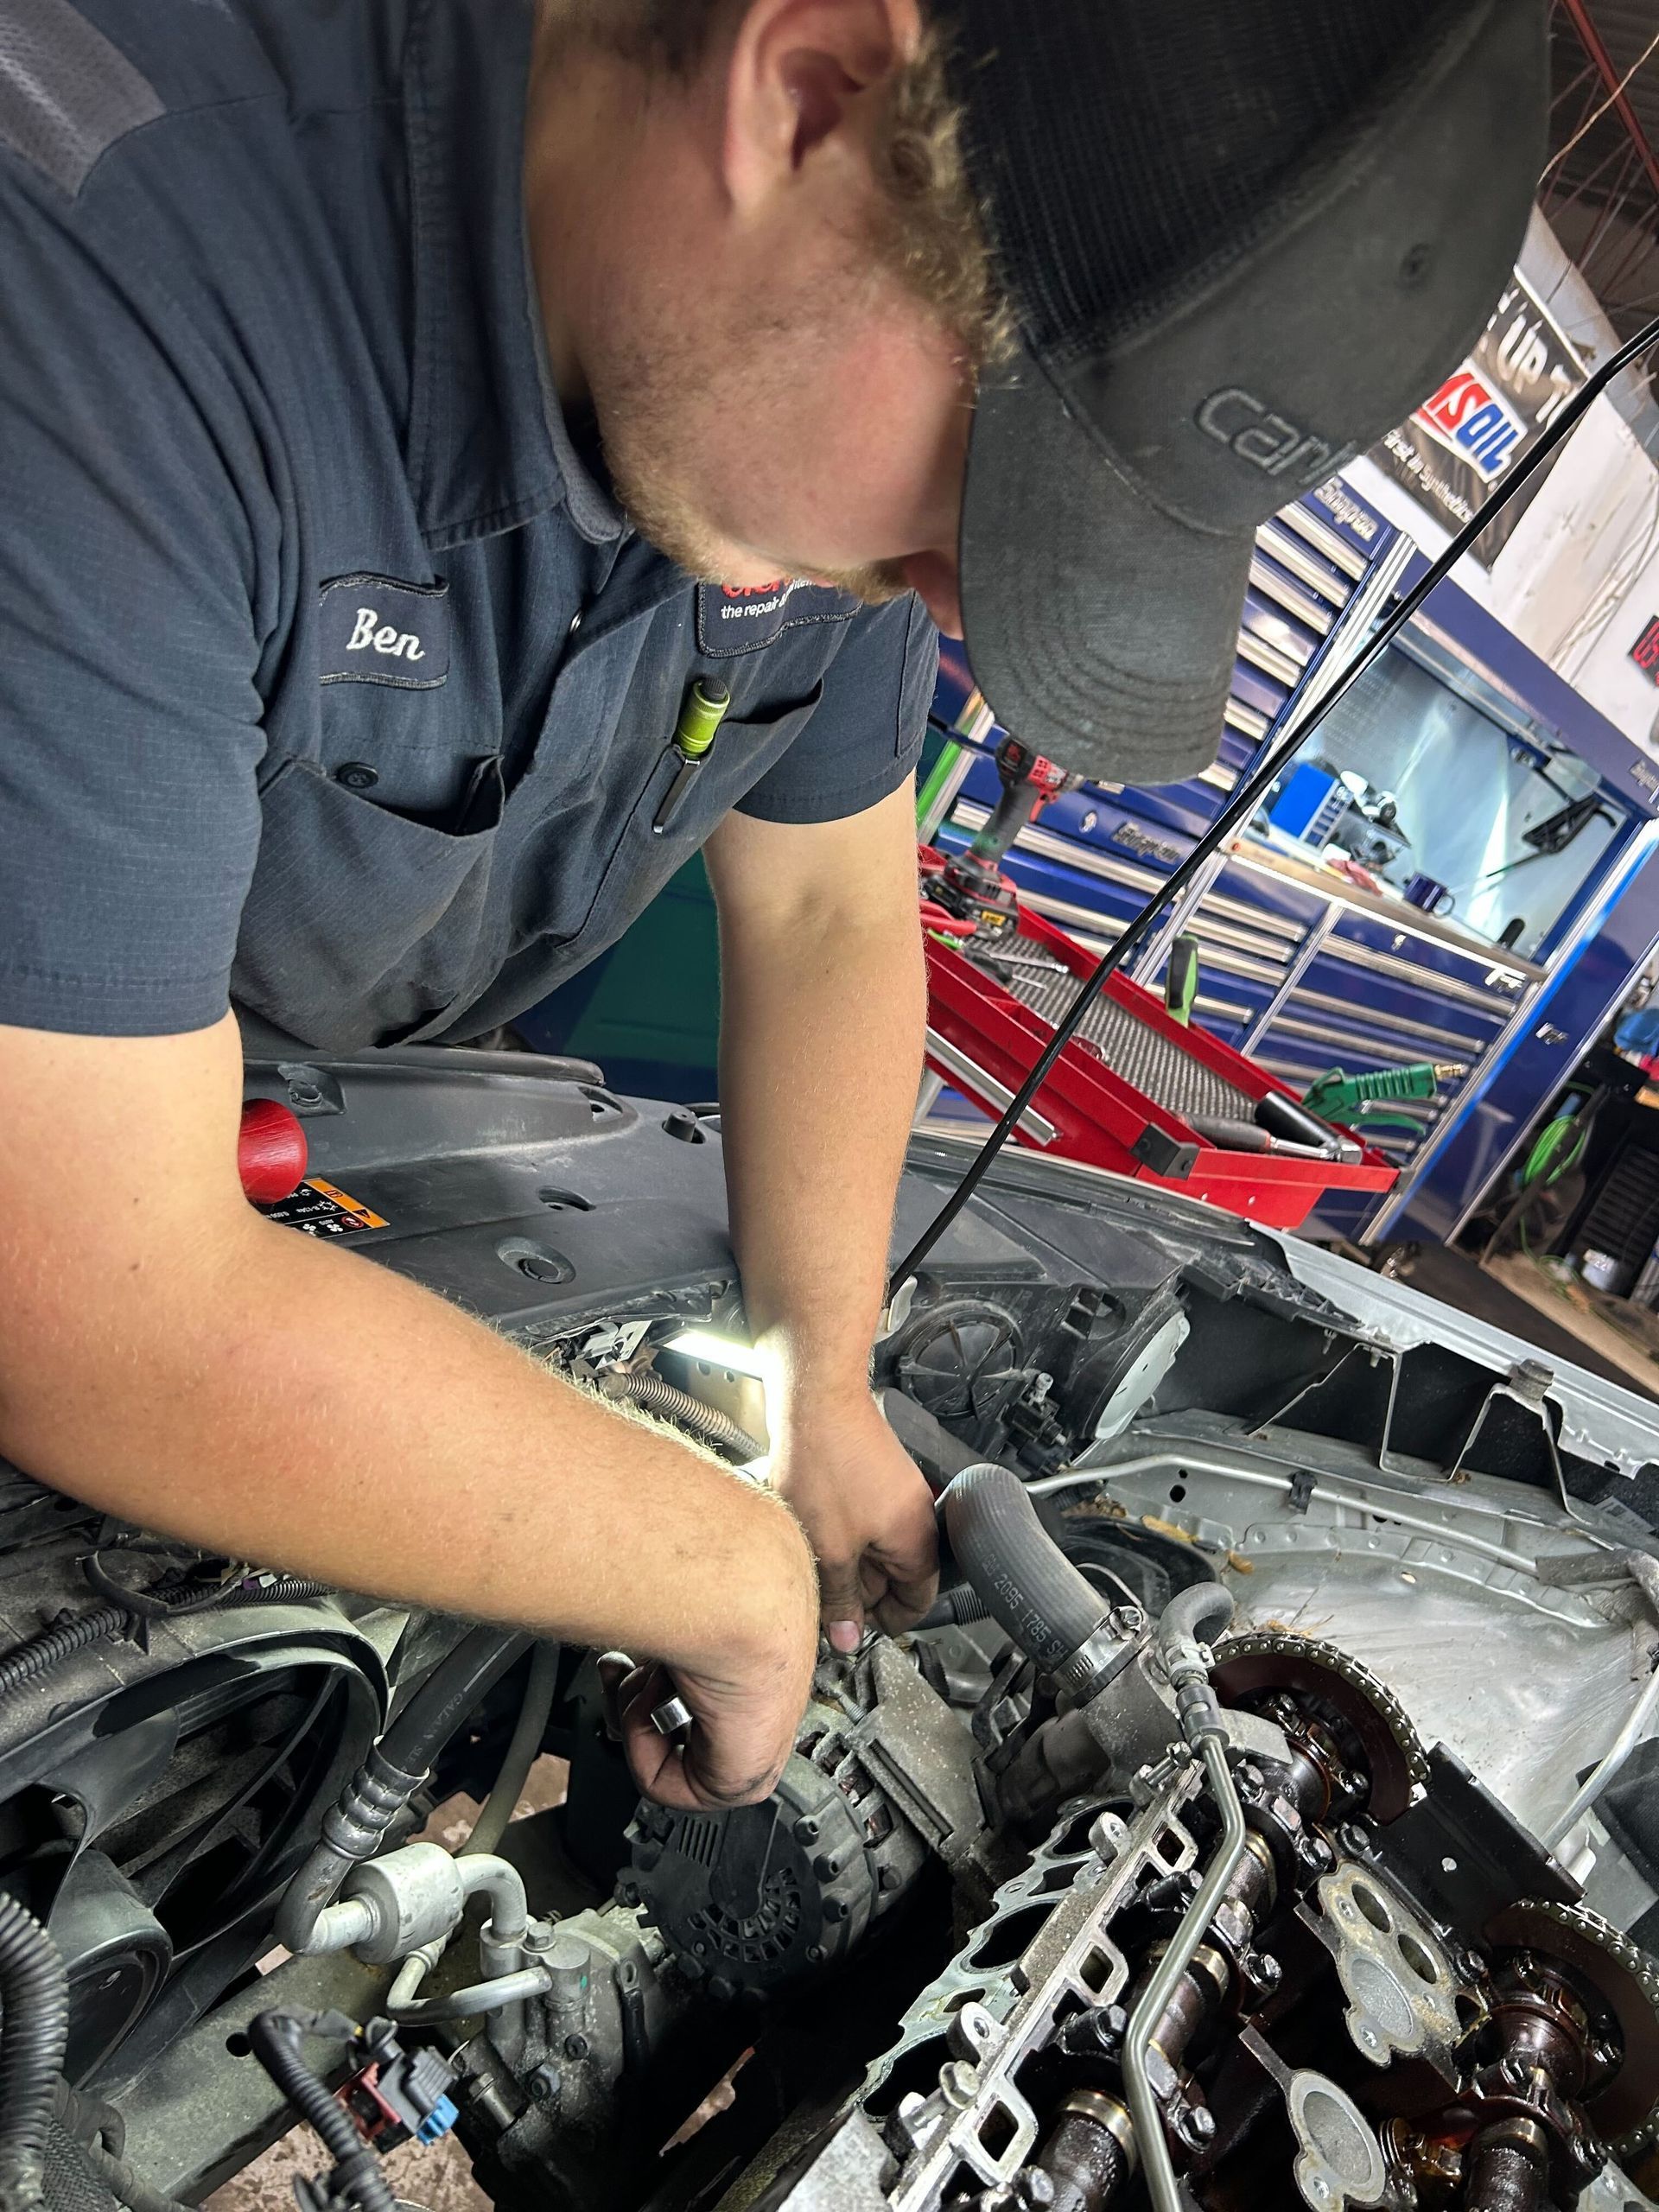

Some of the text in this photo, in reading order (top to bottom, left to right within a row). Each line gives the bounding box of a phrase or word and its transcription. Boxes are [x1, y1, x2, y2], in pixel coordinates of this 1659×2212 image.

[1497, 314, 1548, 395] UP
[346, 607, 426, 661] Ben
[721, 605, 743, 620] the
[744, 596, 779, 618] repair
[994, 1573, 1024, 1611] 2095
[1021, 1608, 1052, 1643] 1785
